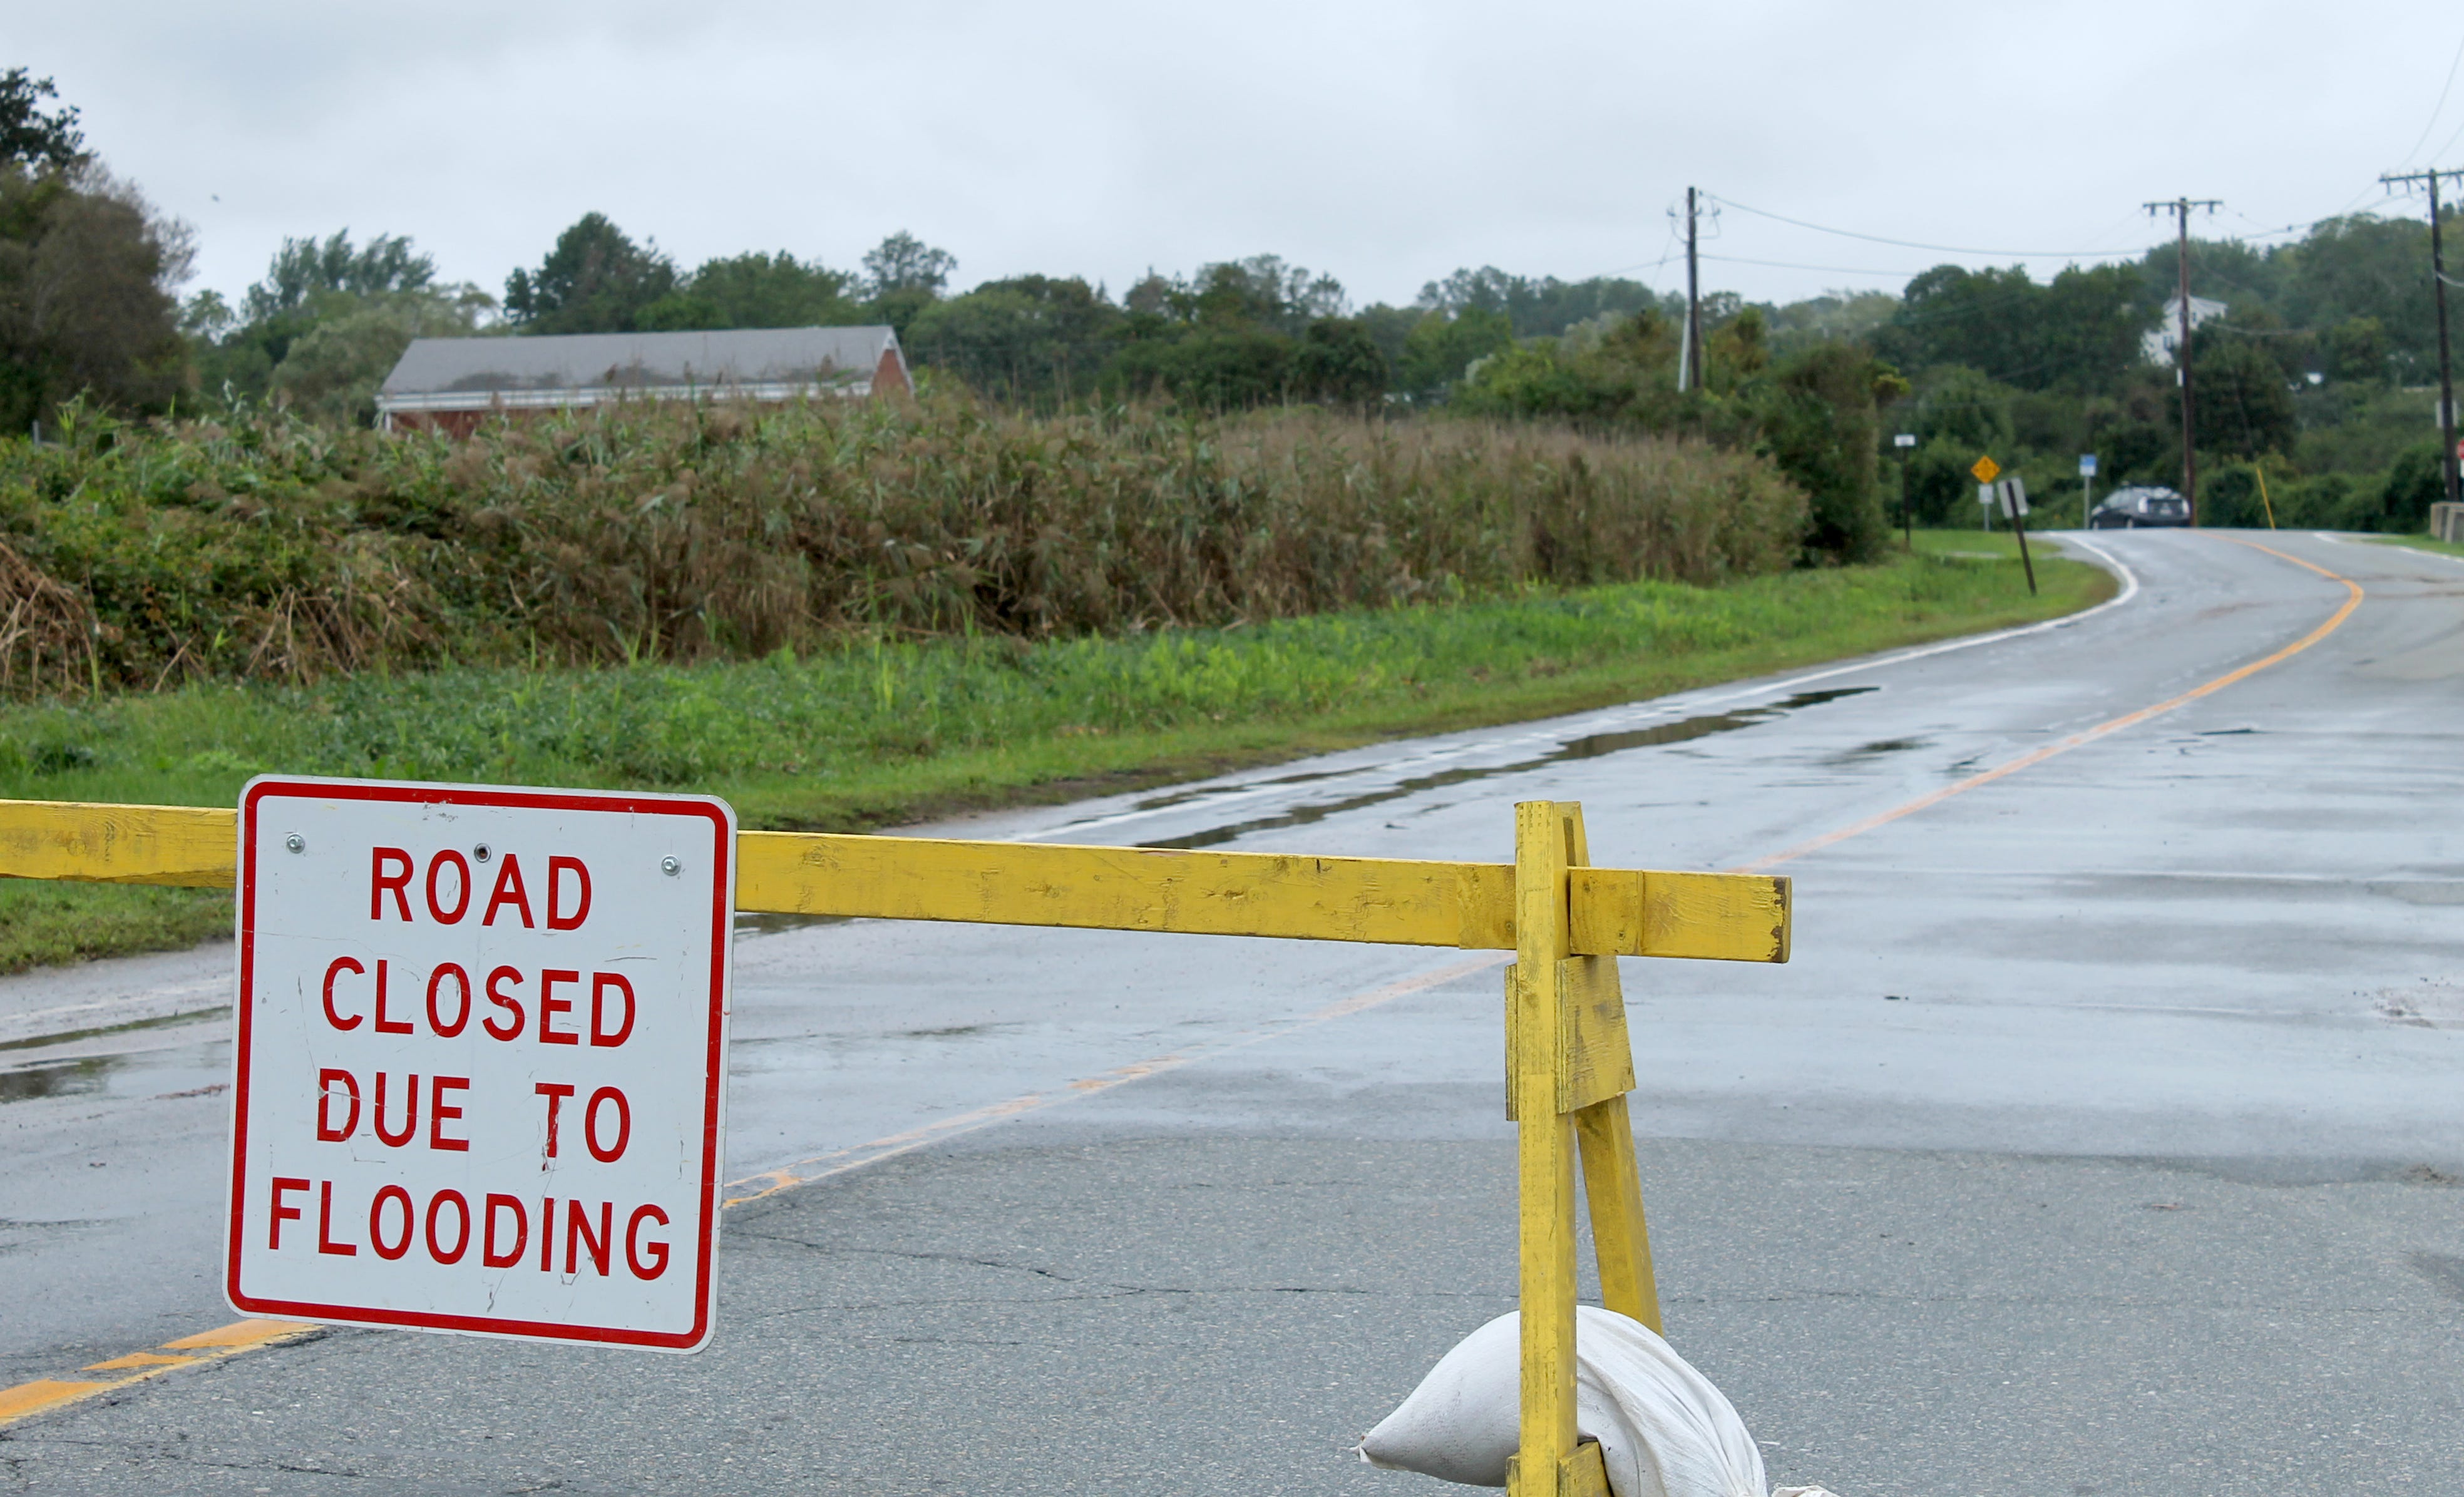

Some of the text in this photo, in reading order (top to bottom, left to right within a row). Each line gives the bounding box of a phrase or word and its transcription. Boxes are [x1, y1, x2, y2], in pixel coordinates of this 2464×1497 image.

[371, 846, 592, 931] ROAD
[322, 956, 636, 1048] CLOSED
[317, 1068, 631, 1163] DUE TO
[269, 1177, 670, 1281] FLOODING
